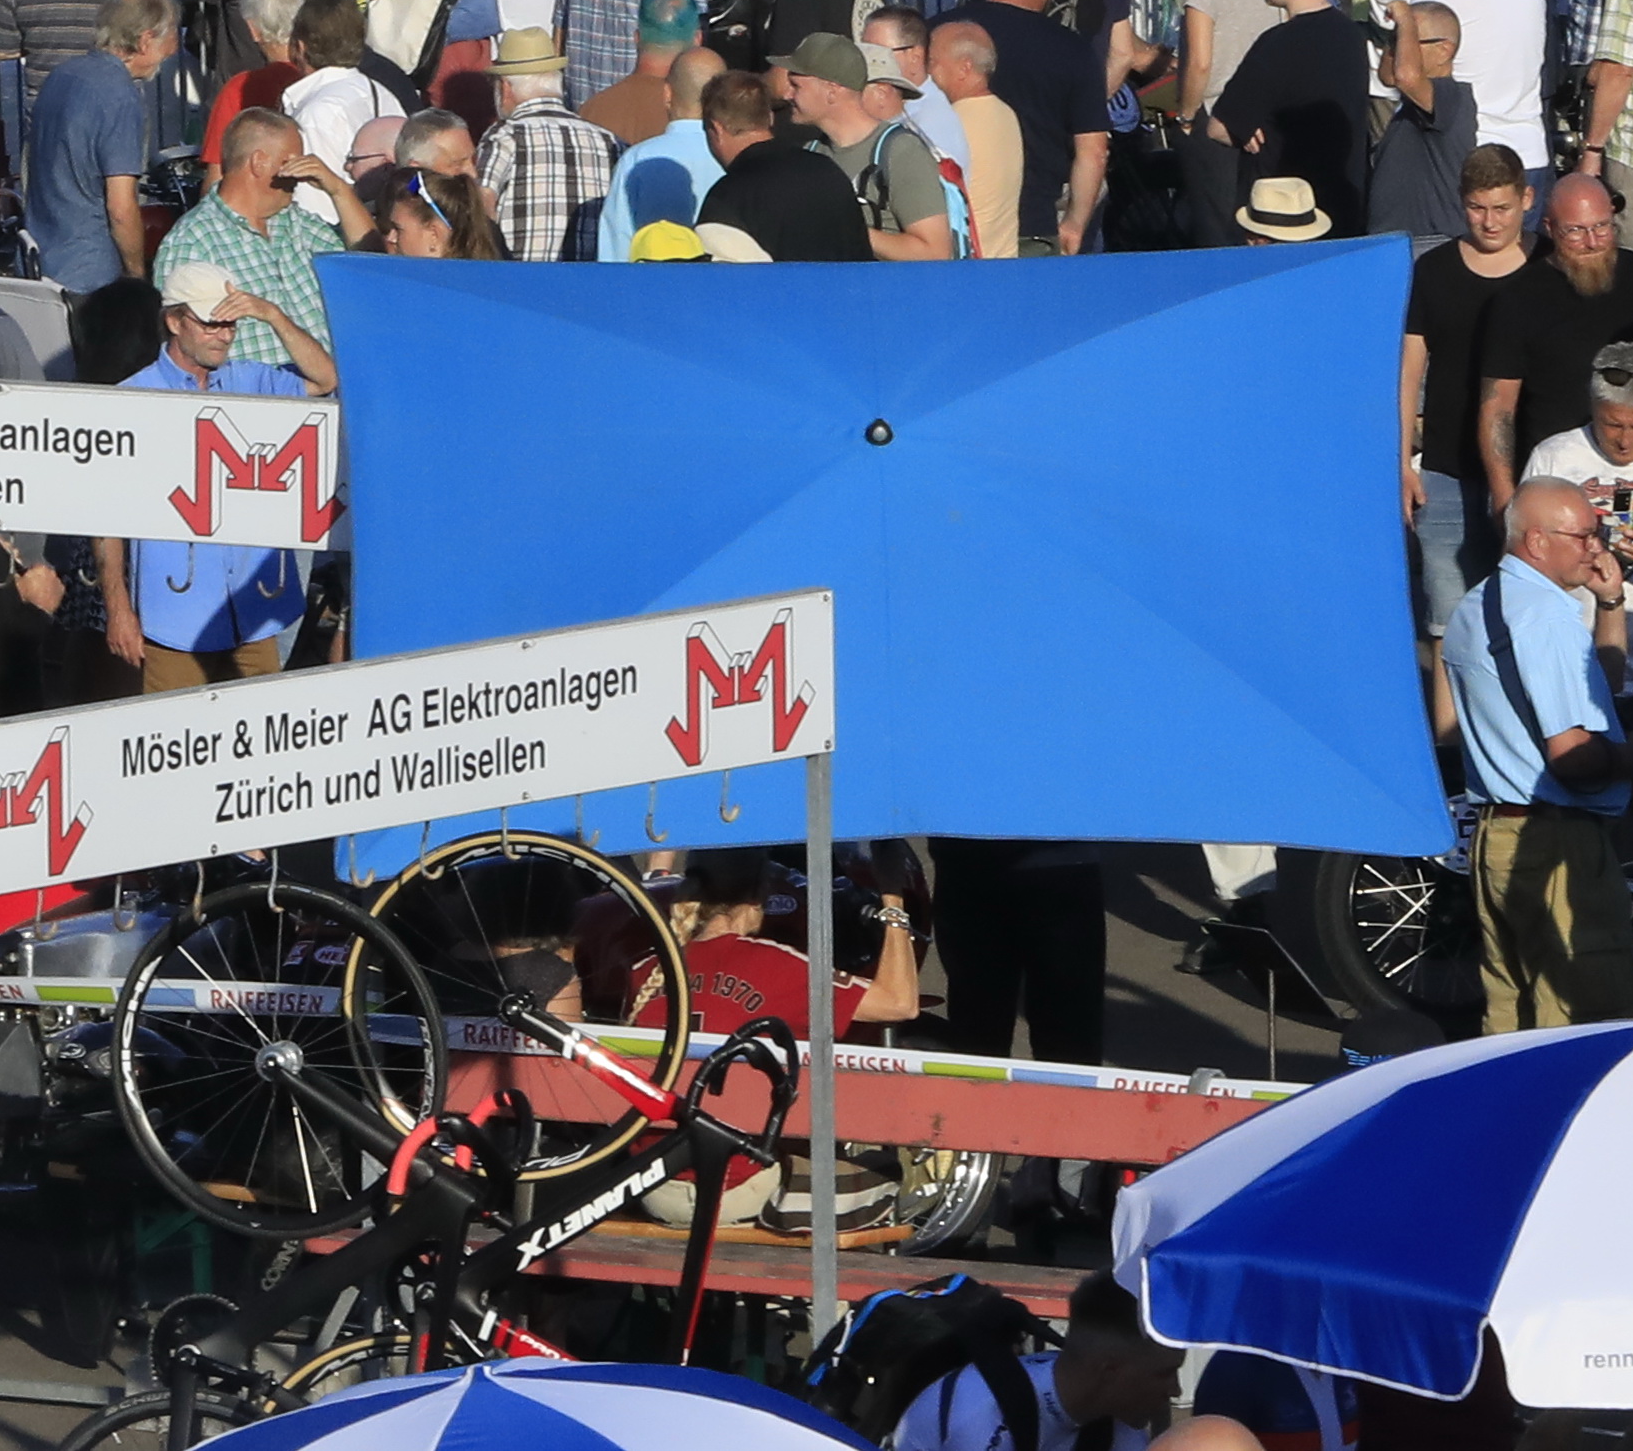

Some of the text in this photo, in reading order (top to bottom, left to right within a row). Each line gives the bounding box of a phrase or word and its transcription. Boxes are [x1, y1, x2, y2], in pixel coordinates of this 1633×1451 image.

[121, 665, 637, 777] Mösler & Meier AG Elektroanlagen
[214, 739, 546, 823] Zürich und Wallisellen
[210, 989, 325, 1016] RAIFFEISEN
[711, 970, 766, 1014] 1970
